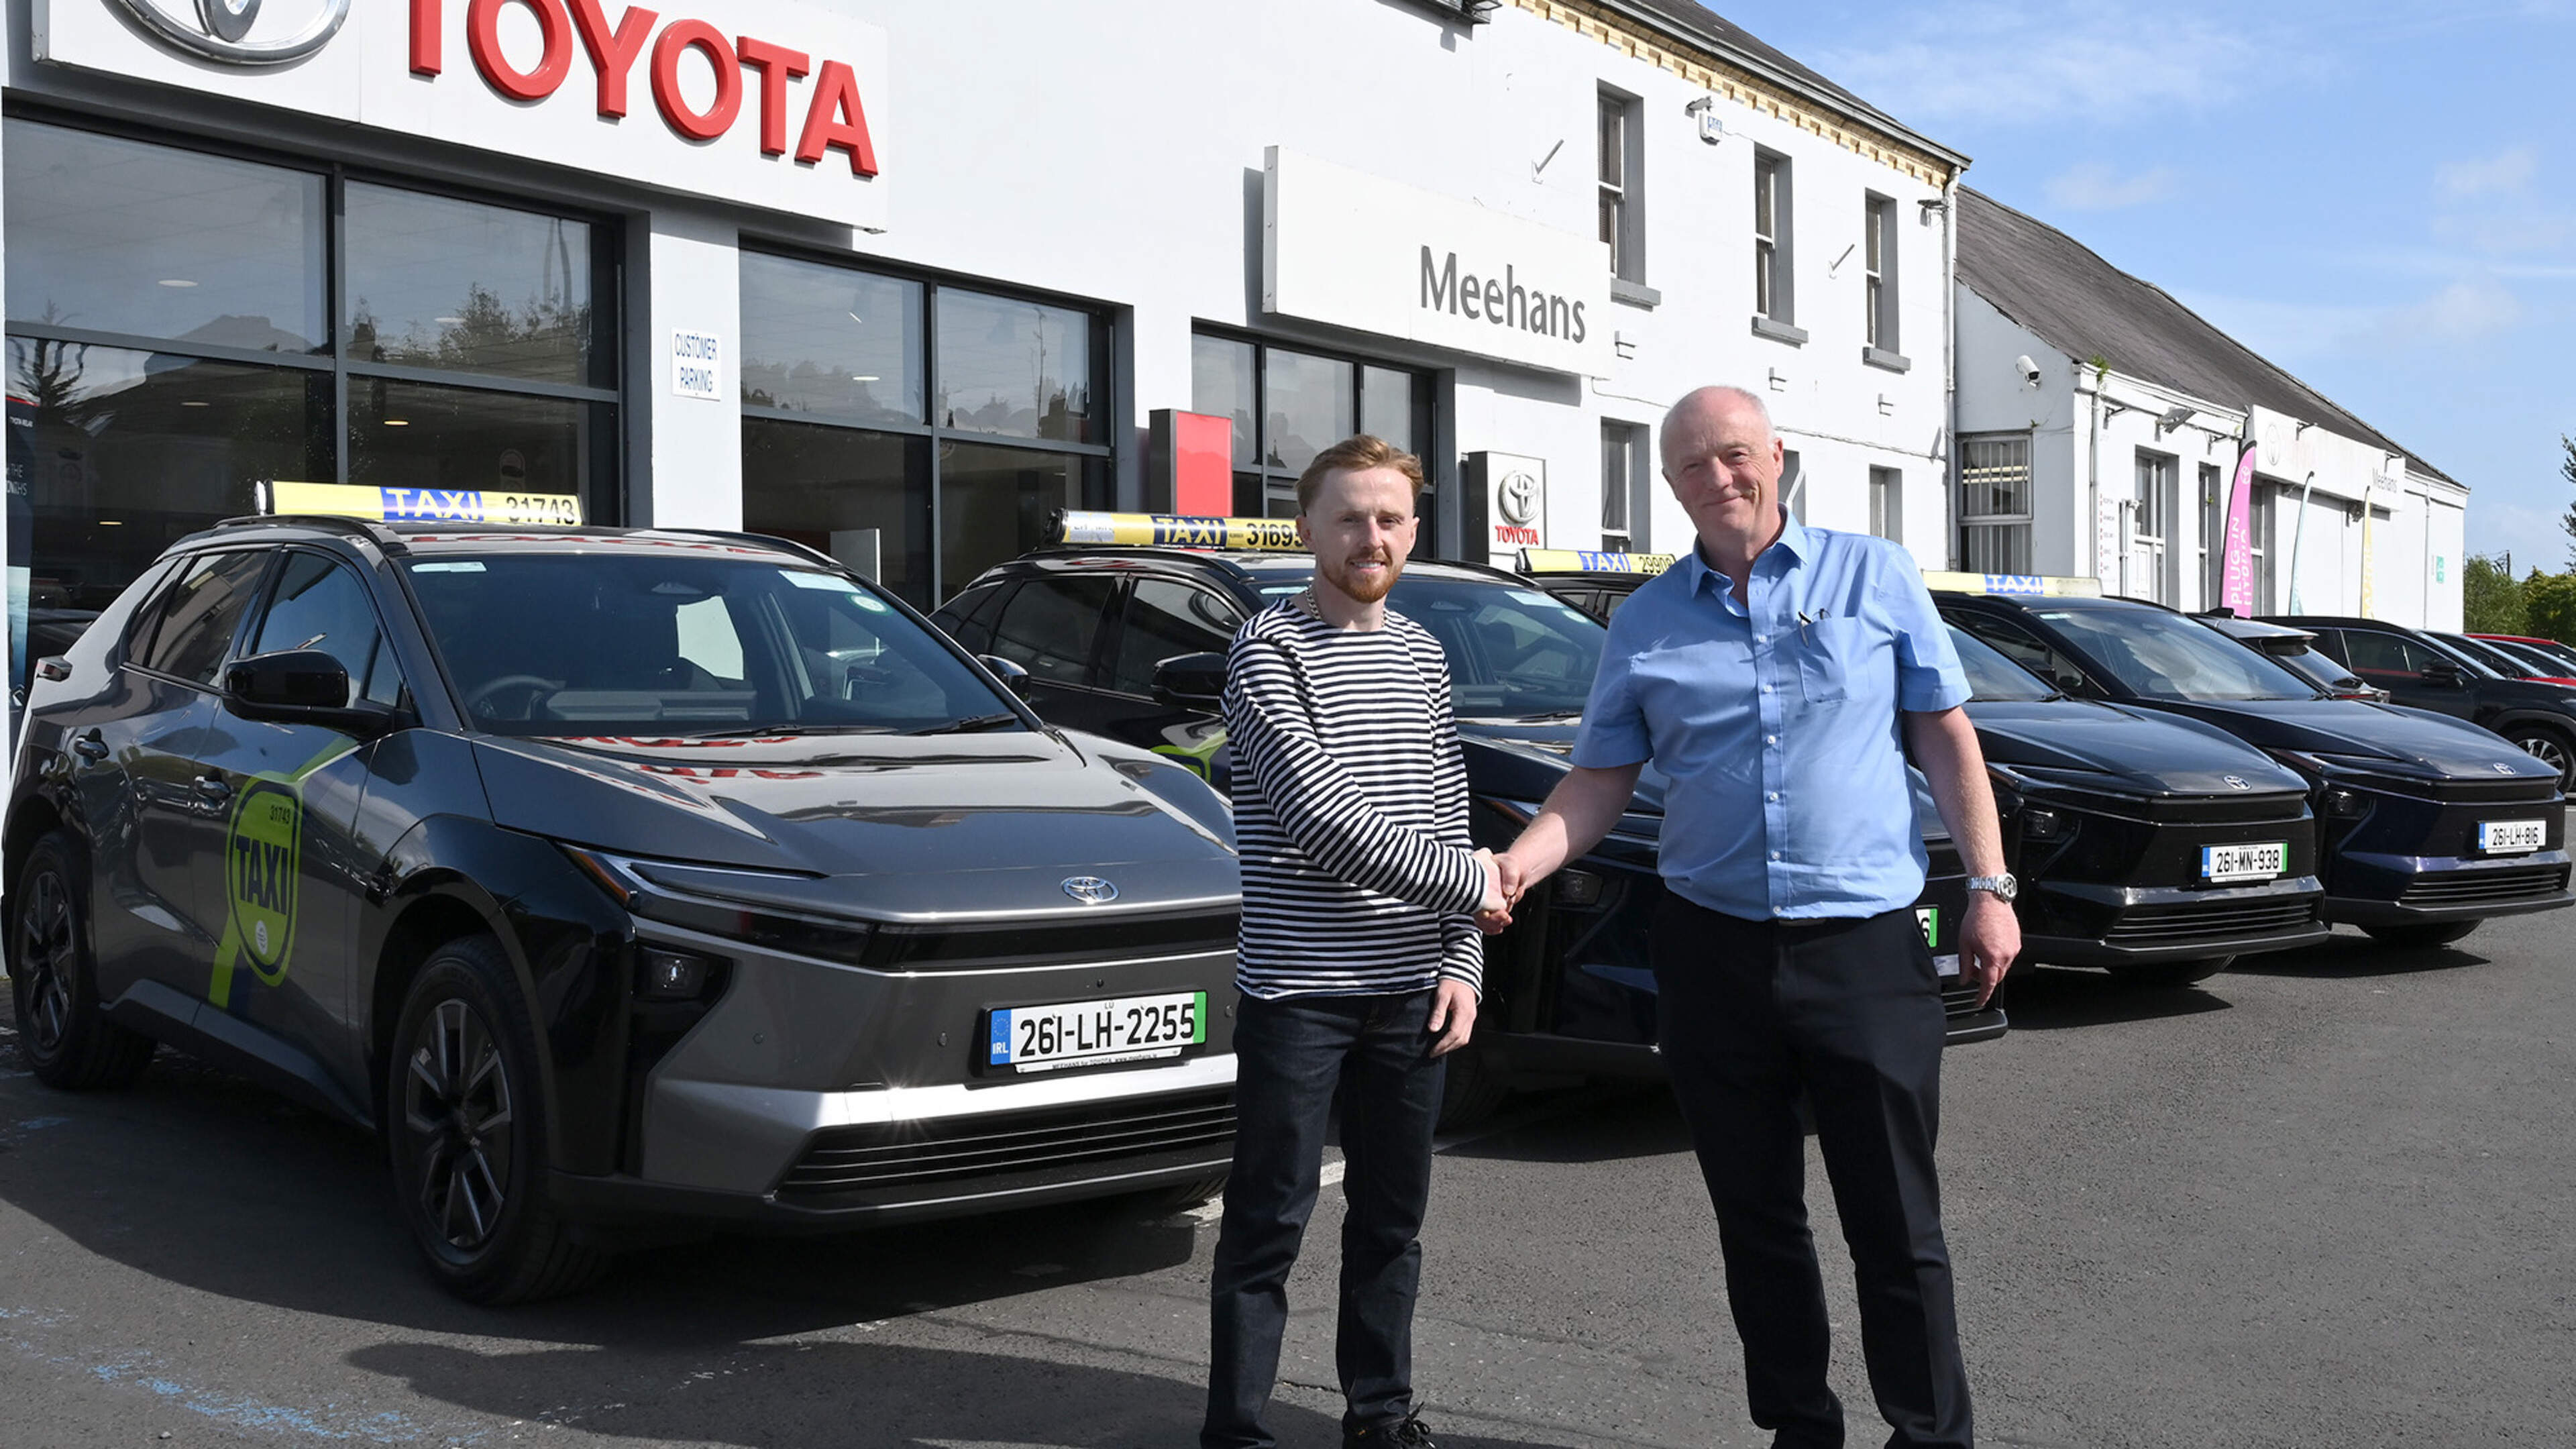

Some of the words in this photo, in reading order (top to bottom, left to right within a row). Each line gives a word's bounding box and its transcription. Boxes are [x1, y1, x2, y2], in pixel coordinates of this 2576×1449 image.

[1420, 244, 1586, 343] Meehans
[675, 333, 717, 360] CUSTOMER
[680, 366, 712, 392] PARKING
[386, 488, 480, 521] TAXI
[506, 496, 576, 525] 31743
[1153, 517, 1222, 545] TAXI
[1495, 525, 1539, 545] TOYOTA
[1582, 552, 1629, 571] TAXI
[2230, 517, 2243, 605] PLUG-IN
[1988, 575, 2043, 593] TAXI
[235, 834, 288, 915] TAXI
[2216, 849, 2279, 873] 261-MN-938
[1019, 1003, 1195, 1057] 261-LH-2255
[992, 1040, 1009, 1055] IRL
